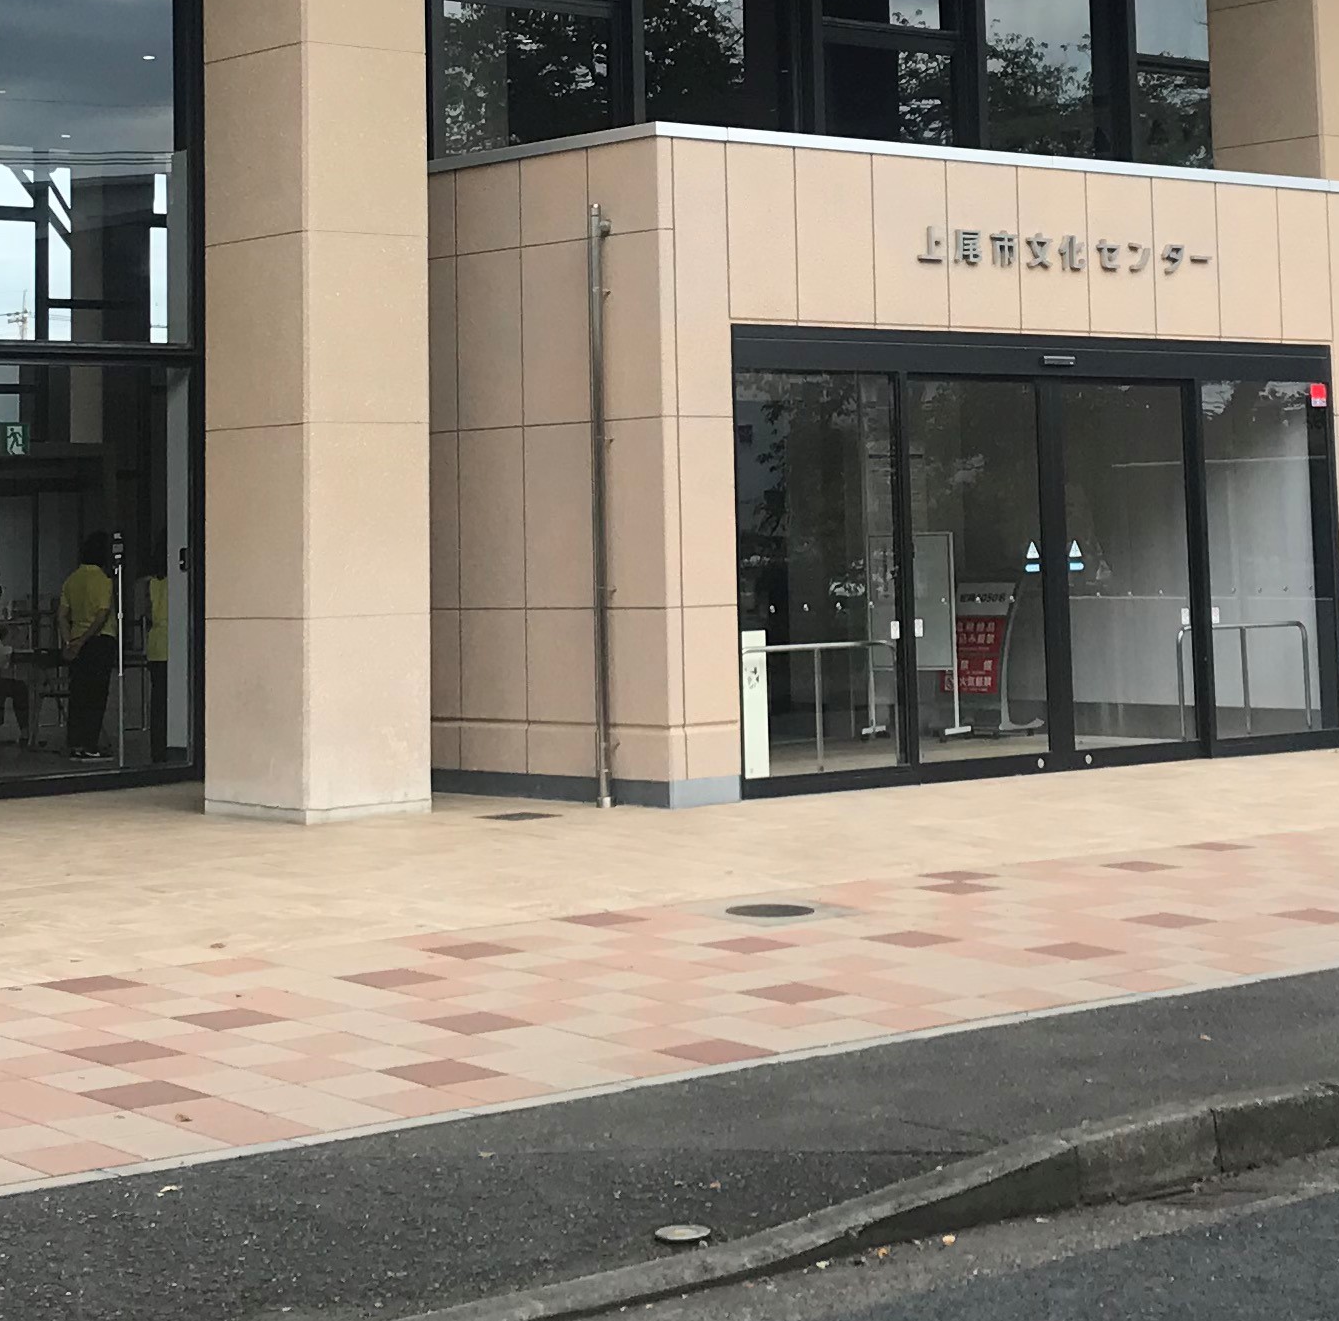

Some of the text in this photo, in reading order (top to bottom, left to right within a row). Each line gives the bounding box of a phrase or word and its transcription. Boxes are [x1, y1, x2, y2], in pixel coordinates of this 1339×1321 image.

[917, 226, 1212, 274] 上尾市文化センター
